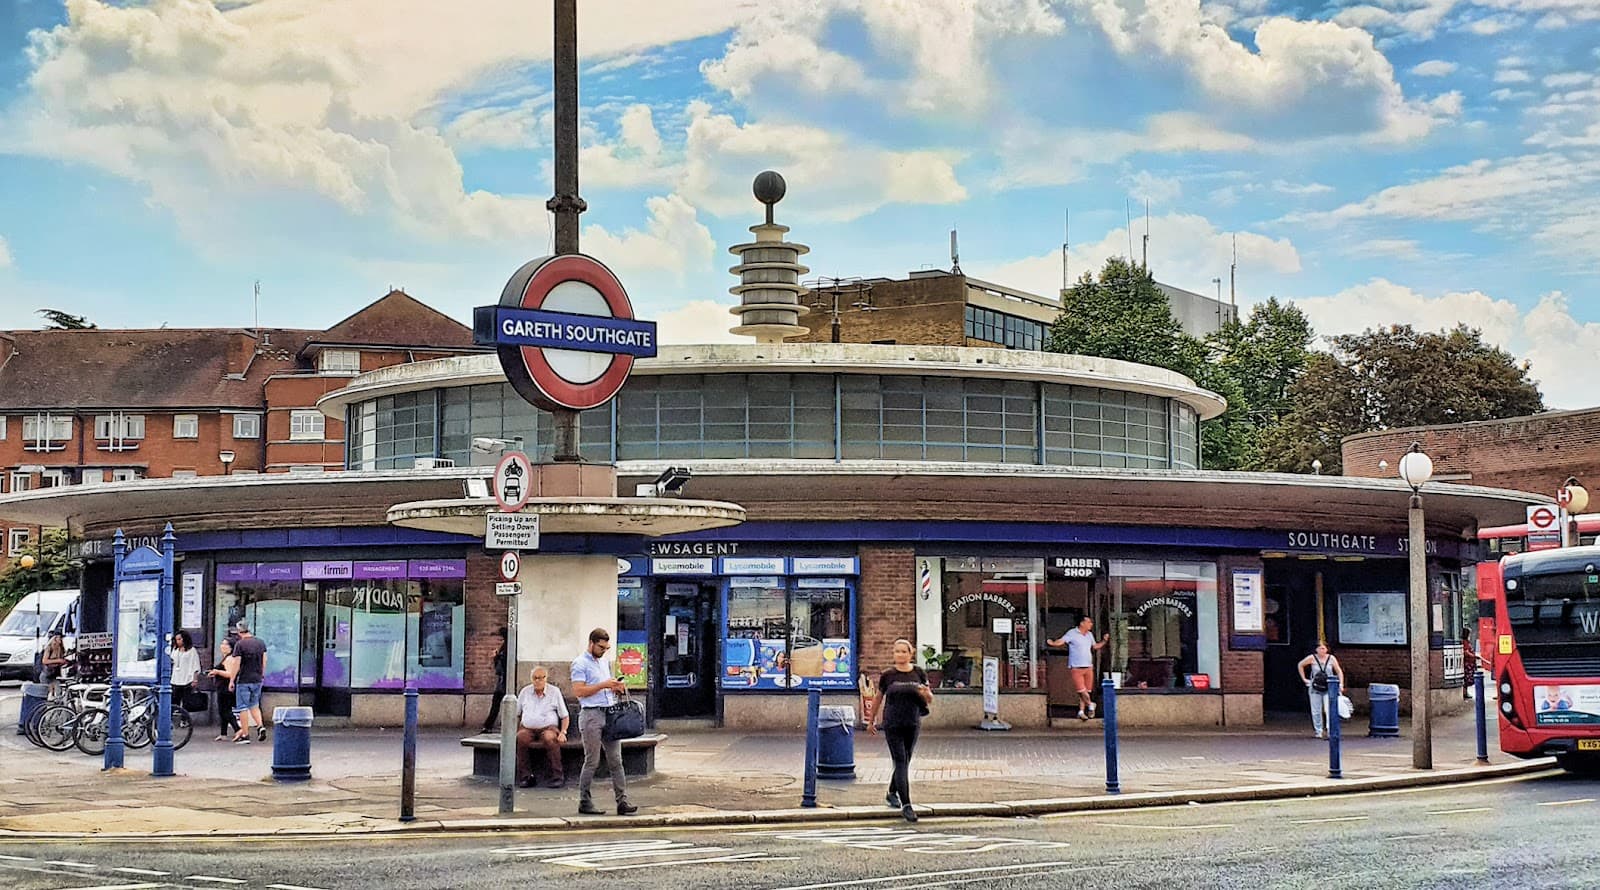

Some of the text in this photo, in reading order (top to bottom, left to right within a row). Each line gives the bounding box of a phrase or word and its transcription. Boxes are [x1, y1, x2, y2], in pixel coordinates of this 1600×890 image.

[502, 319, 651, 347] GARETH SOUTHGATE
[1557, 490, 1570, 502] H
[489, 515, 513, 523] Picking
[491, 523, 515, 531] Setting
[1288, 532, 1438, 553] SOUTHGATE STON
[651, 543, 739, 554] WSAGENT
[504, 559, 516, 572] 10
[658, 562, 705, 571] Lycamobile
[729, 562, 776, 571] Lycamobile
[799, 562, 846, 571] Lycamobile
[1056, 558, 1101, 568] BARBER
[1064, 568, 1093, 577] SHOP
[949, 593, 1016, 613] STATION BARBERS
[1136, 597, 1193, 618] STATION BARBERS
[1580, 611, 1600, 633] W
